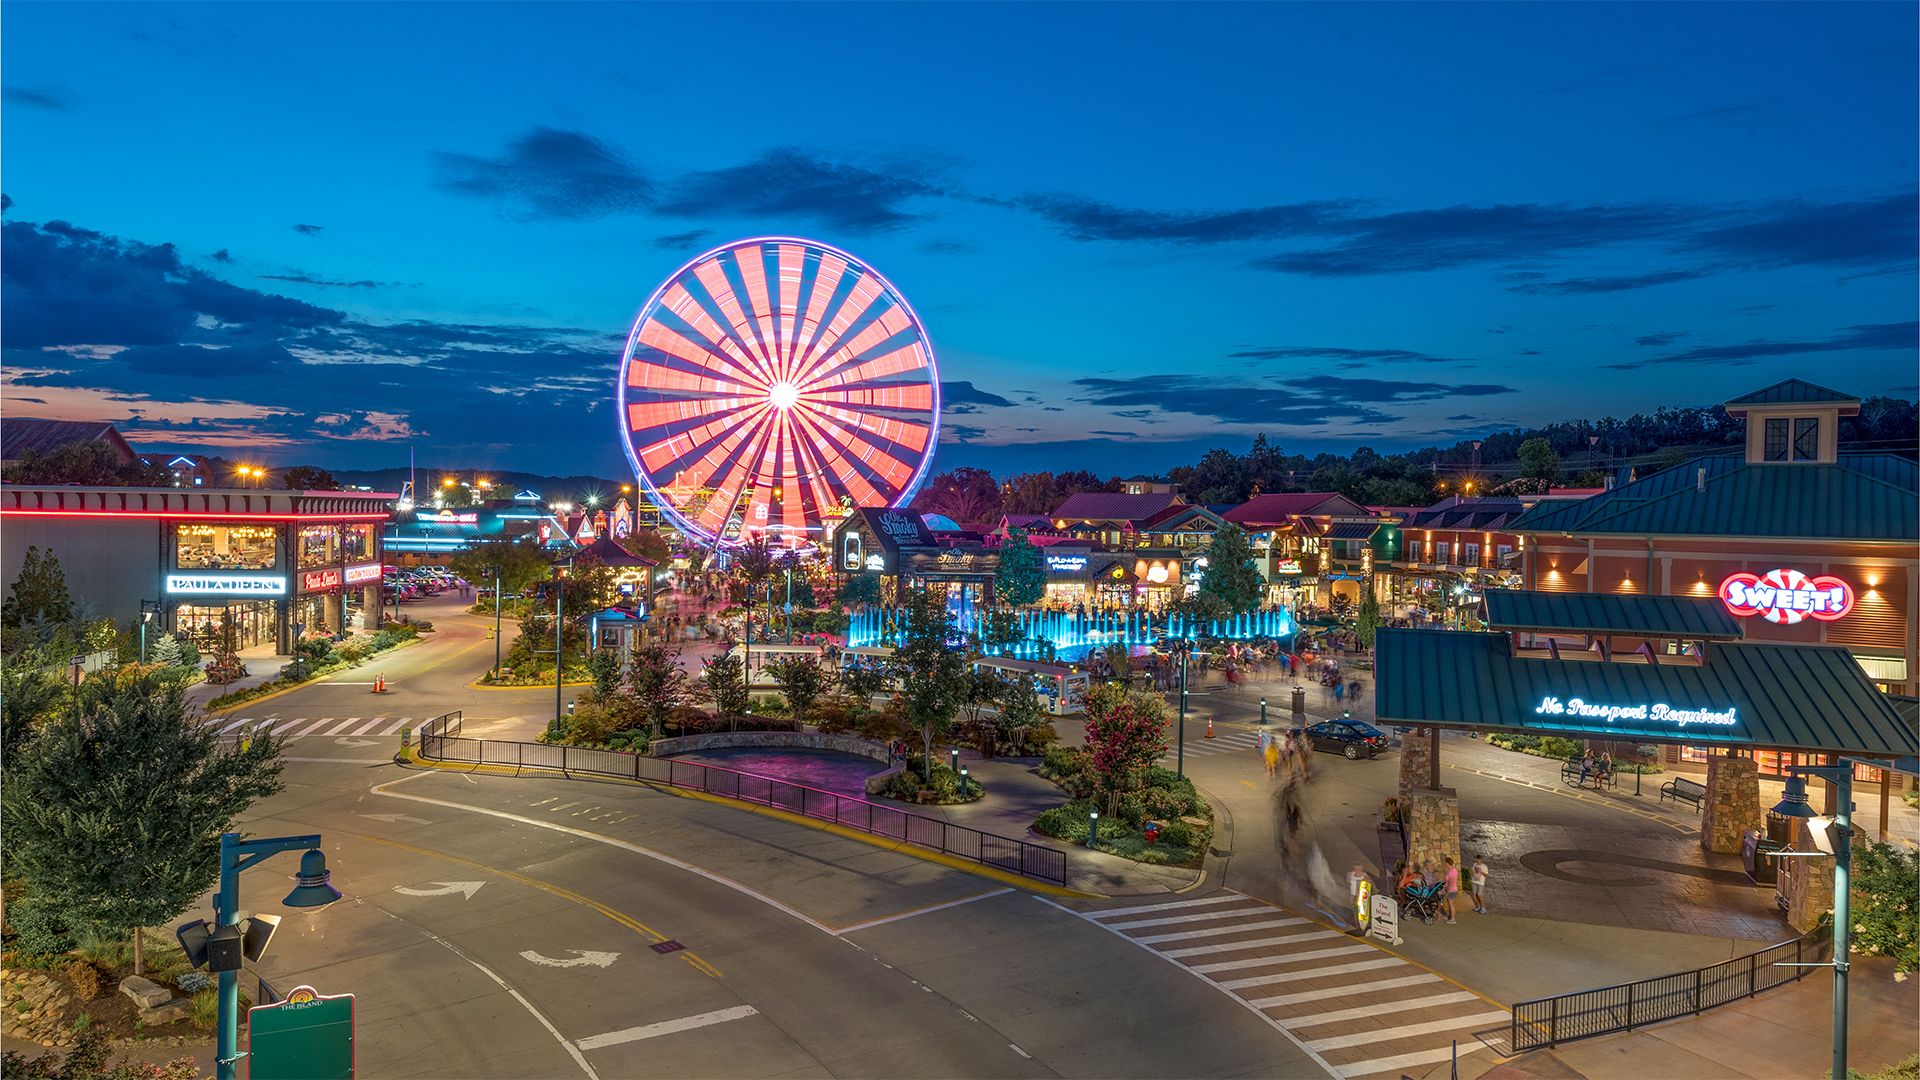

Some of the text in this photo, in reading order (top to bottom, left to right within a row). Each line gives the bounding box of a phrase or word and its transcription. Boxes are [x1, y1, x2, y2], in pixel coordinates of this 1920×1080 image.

[879, 513, 919, 537] Smoky
[937, 554, 974, 566] Smoky
[176, 580, 273, 590] PAULA DEEN
[1726, 580, 1845, 612] SWEET!
[1536, 697, 1736, 727] No Passport Required
[1376, 908, 1391, 917] Island
[296, 1000, 323, 1008] ISLAND
